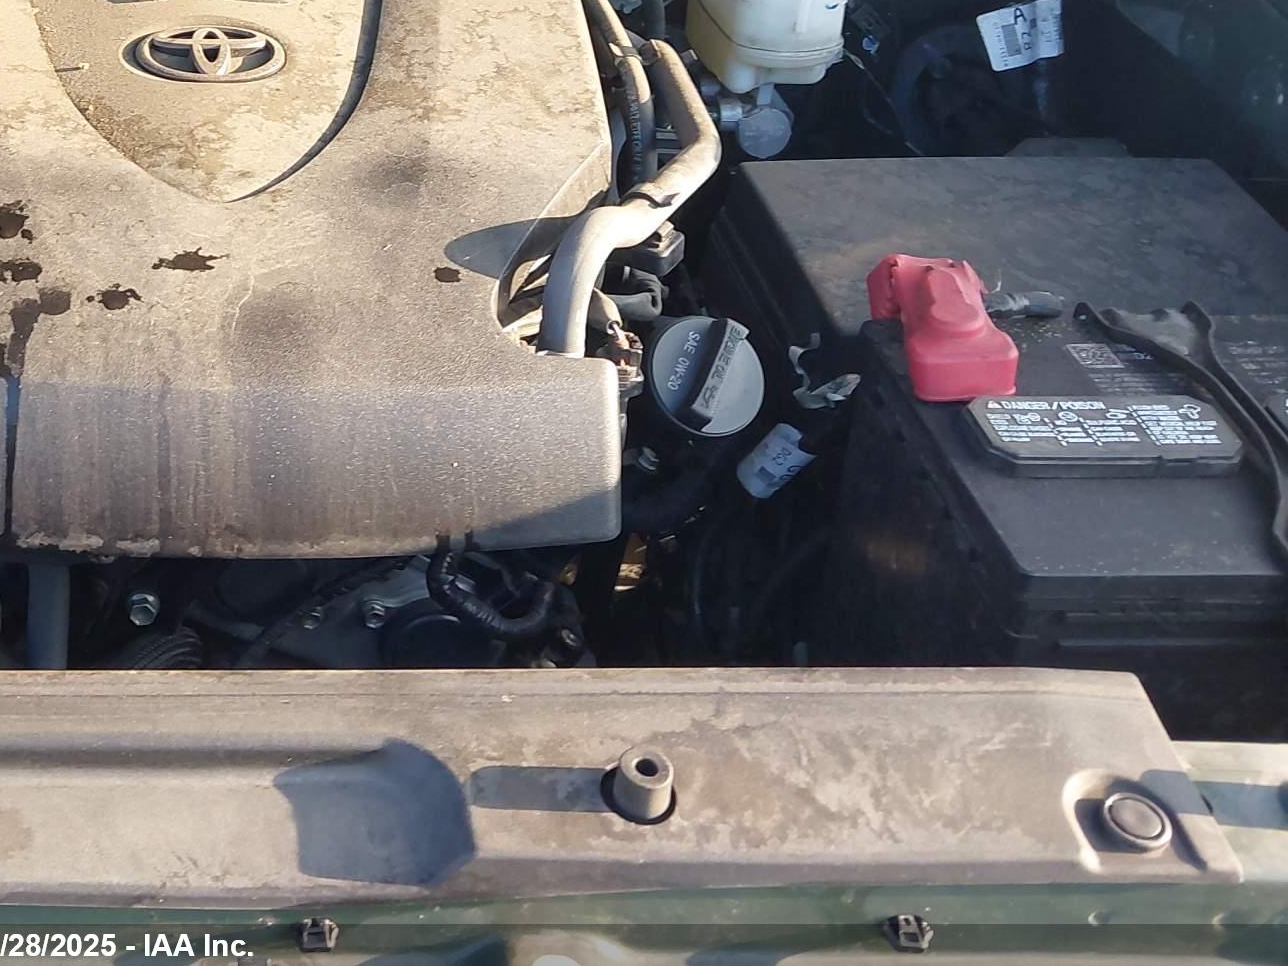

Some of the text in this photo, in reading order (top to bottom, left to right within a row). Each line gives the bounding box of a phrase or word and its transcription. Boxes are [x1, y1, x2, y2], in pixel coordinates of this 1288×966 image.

[667, 330, 702, 391] SAE 0W-20
[1000, 401, 1050, 410] DANGER
[1059, 401, 1106, 410] POISON
